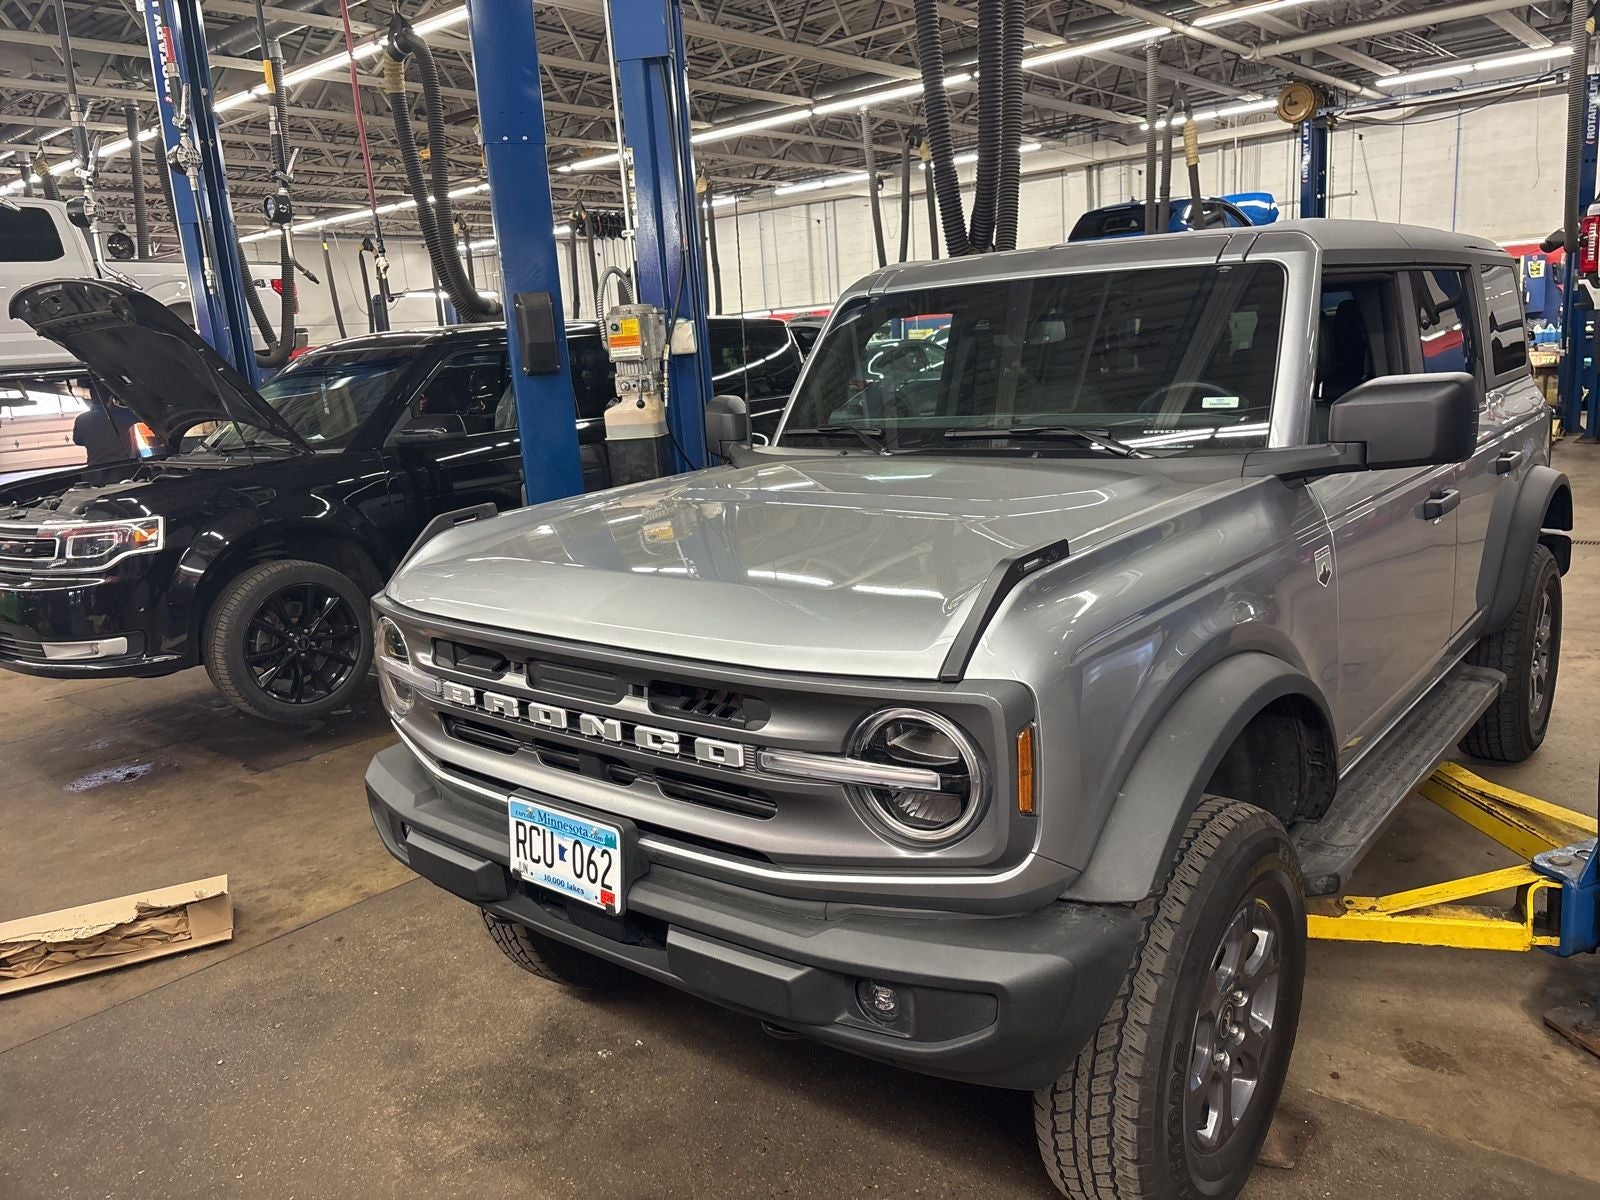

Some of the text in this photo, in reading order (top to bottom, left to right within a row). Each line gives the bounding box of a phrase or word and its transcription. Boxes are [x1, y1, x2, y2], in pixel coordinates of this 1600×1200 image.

[1587, 75, 1599, 139] ROTARY LIFT
[443, 681, 744, 768] BRONCO
[515, 820, 613, 891] RCU 062
[544, 873, 585, 895] 10,000 lakes
